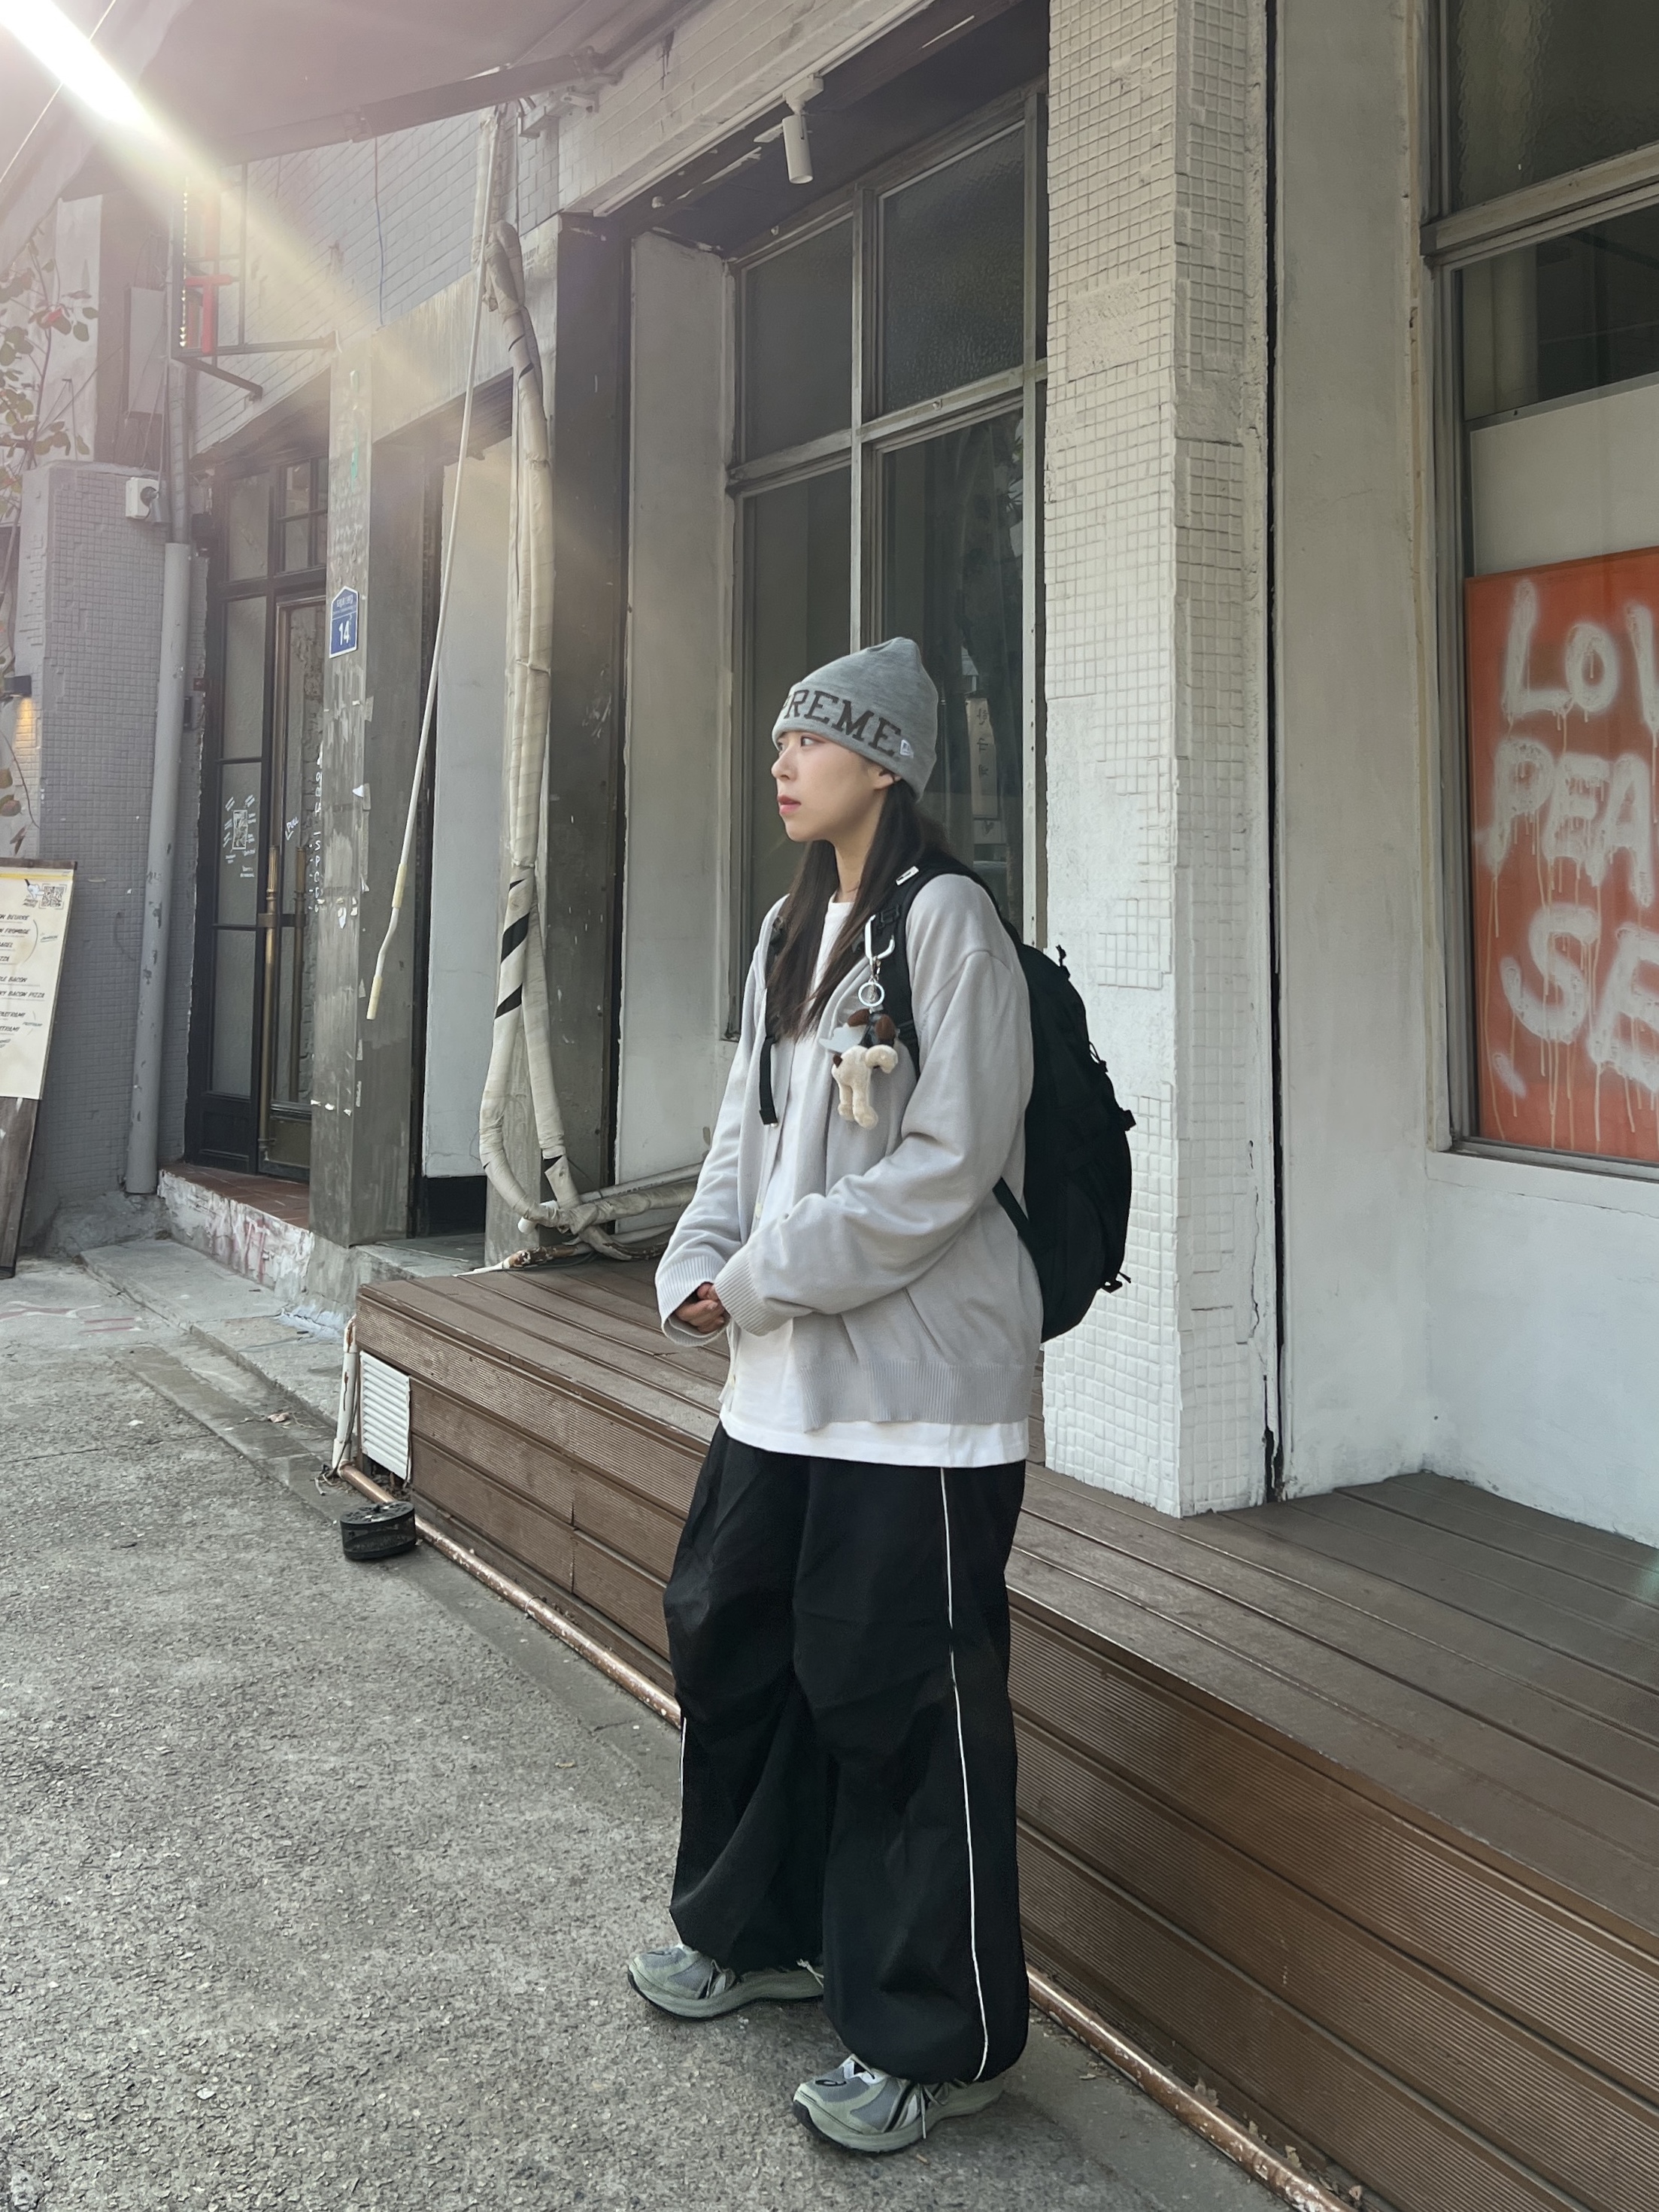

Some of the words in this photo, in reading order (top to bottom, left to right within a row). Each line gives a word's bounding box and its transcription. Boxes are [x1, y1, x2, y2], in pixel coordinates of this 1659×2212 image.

[338, 621, 350, 646] 14
[783, 689, 902, 757] REME
[1486, 738, 1651, 908] PEA
